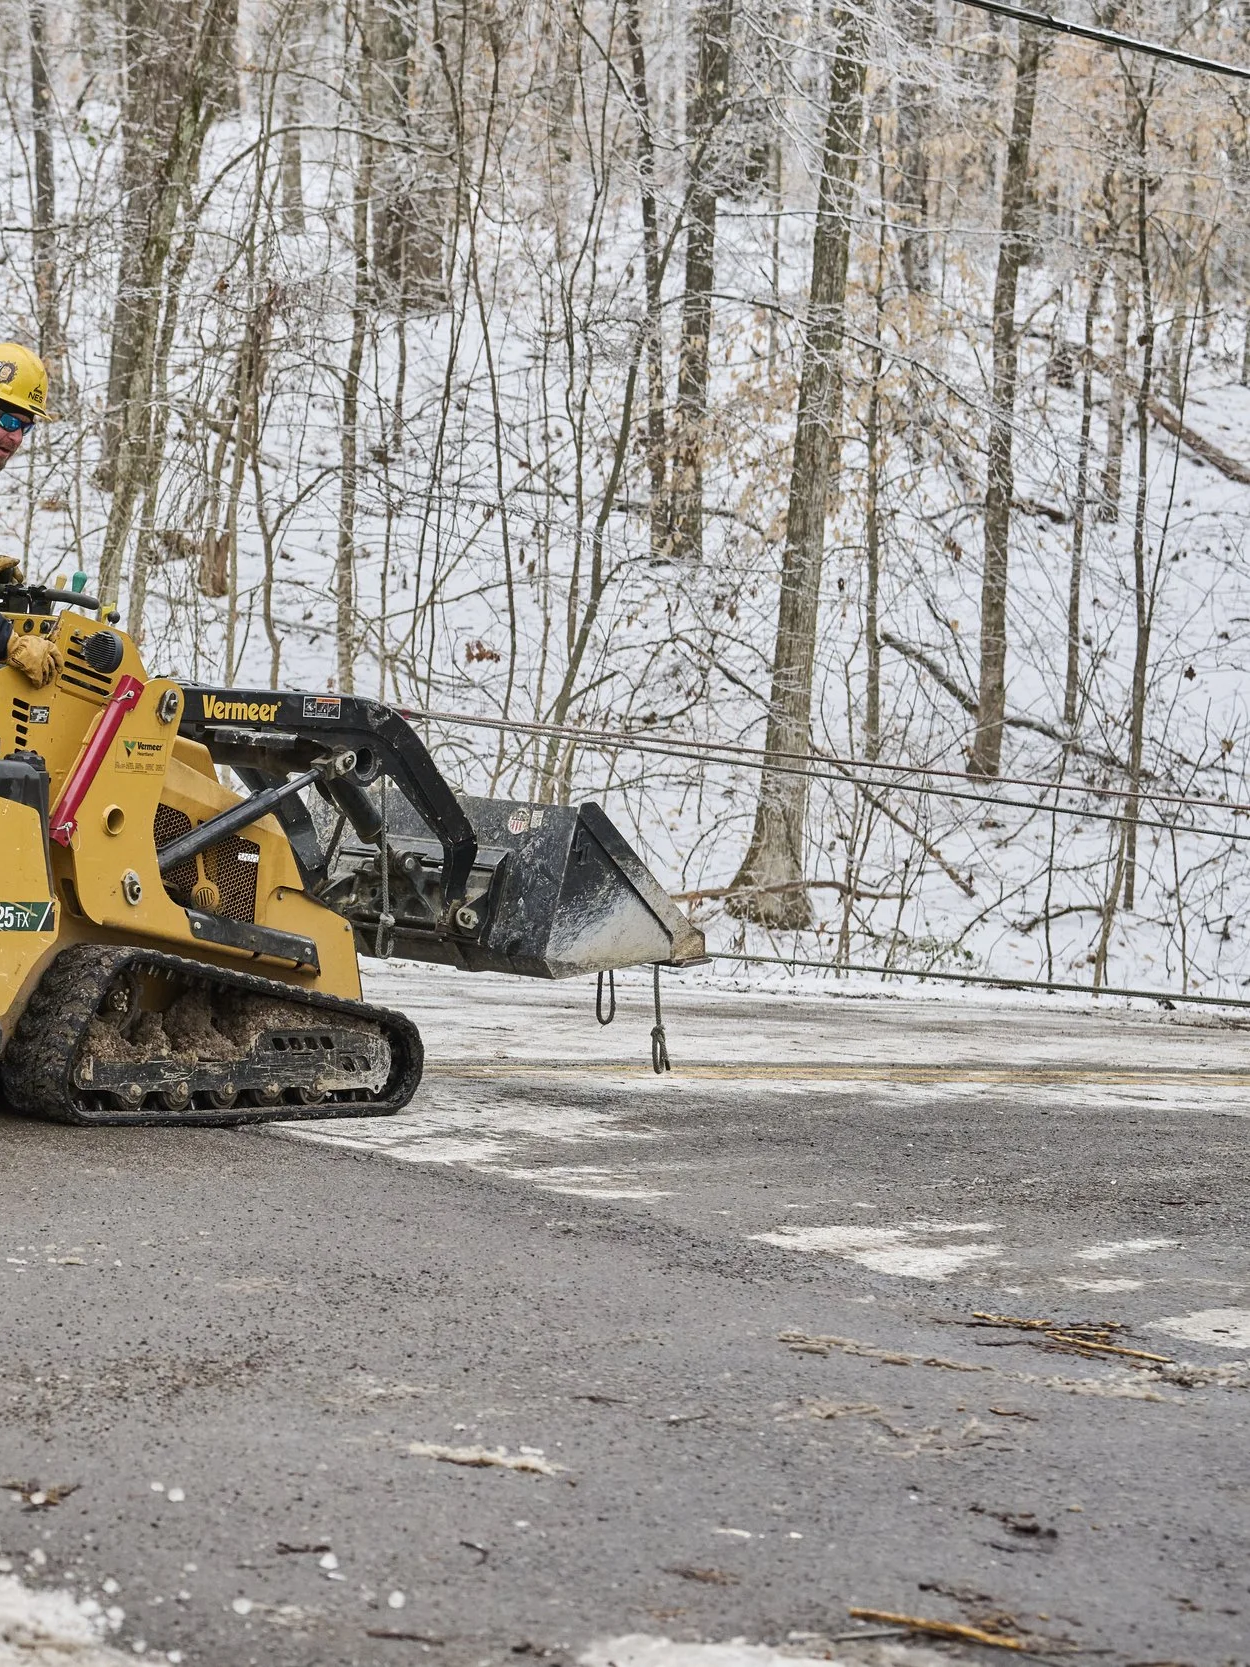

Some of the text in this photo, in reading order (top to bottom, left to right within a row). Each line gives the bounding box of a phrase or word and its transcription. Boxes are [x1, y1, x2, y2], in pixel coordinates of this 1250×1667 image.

[28, 391, 44, 404] NES
[202, 694, 278, 722] Vermeer
[137, 741, 163, 751] Vermeer
